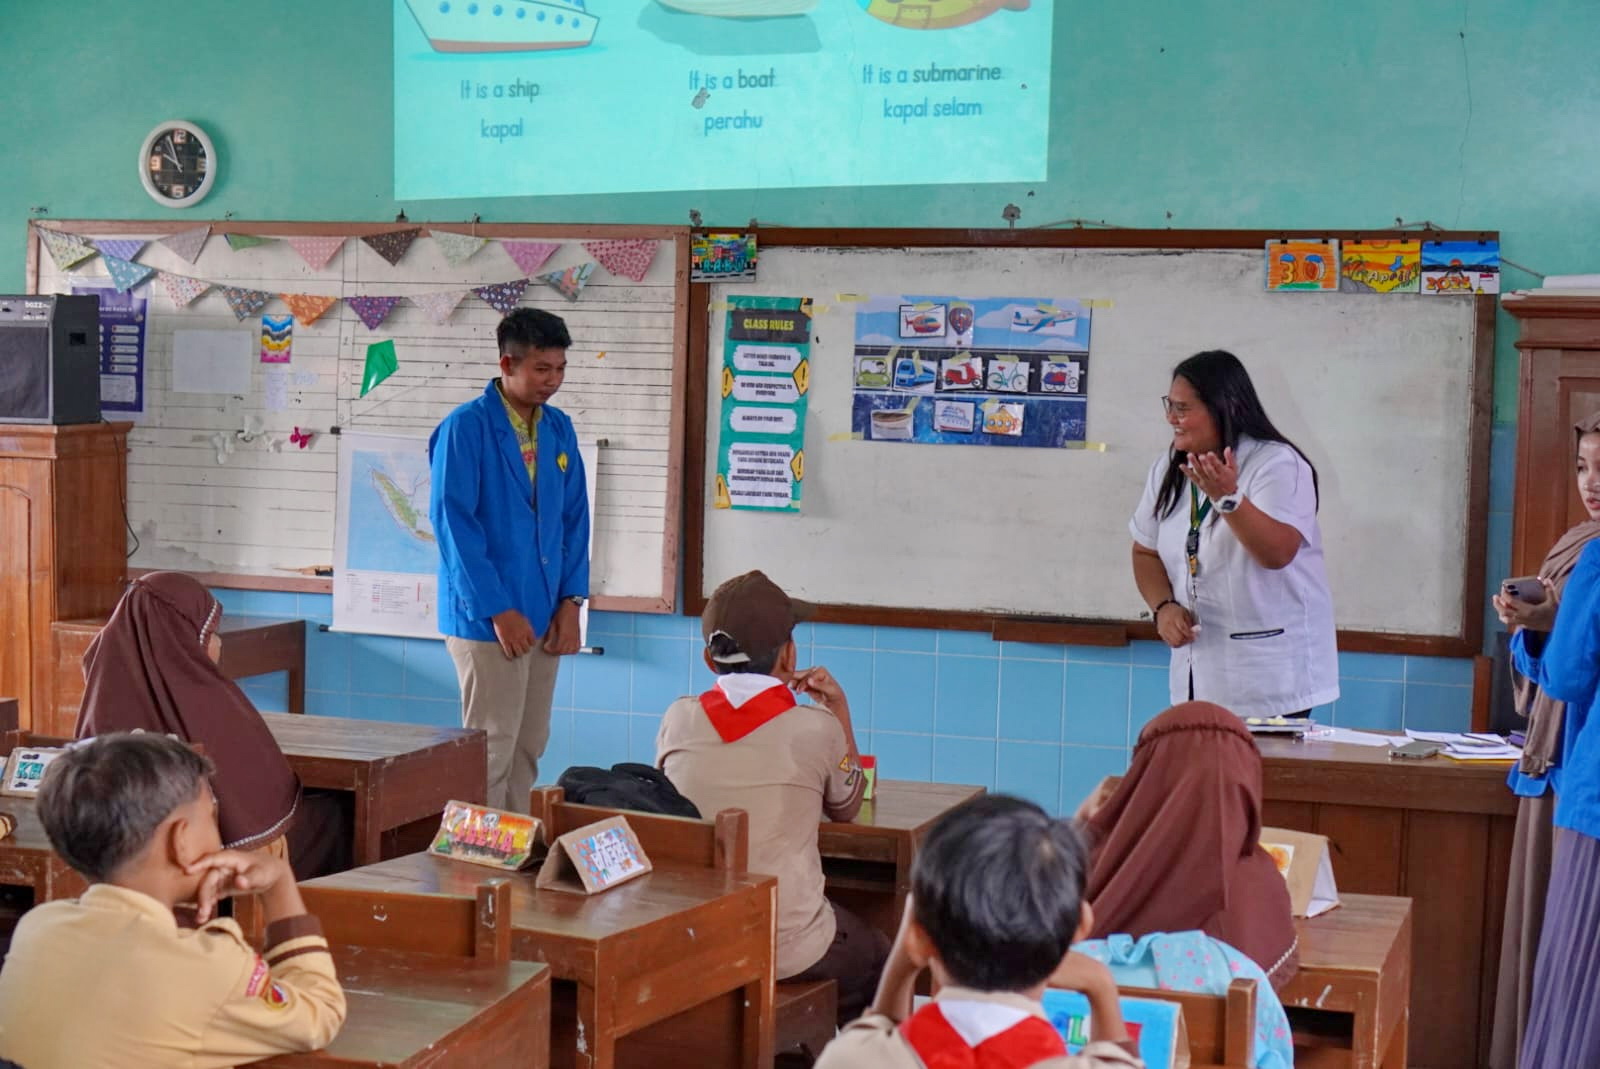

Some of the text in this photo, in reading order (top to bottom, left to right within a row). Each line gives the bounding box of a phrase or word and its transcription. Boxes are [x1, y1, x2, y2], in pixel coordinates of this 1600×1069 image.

[689, 67, 775, 90] It is a boat
[863, 62, 1001, 84] It is a submarine
[461, 77, 540, 103] It is a ship
[704, 109, 763, 136] perahu
[884, 96, 983, 124] kapal selam
[481, 117, 524, 144] kapal
[743, 318, 794, 331] CLASS RULES
